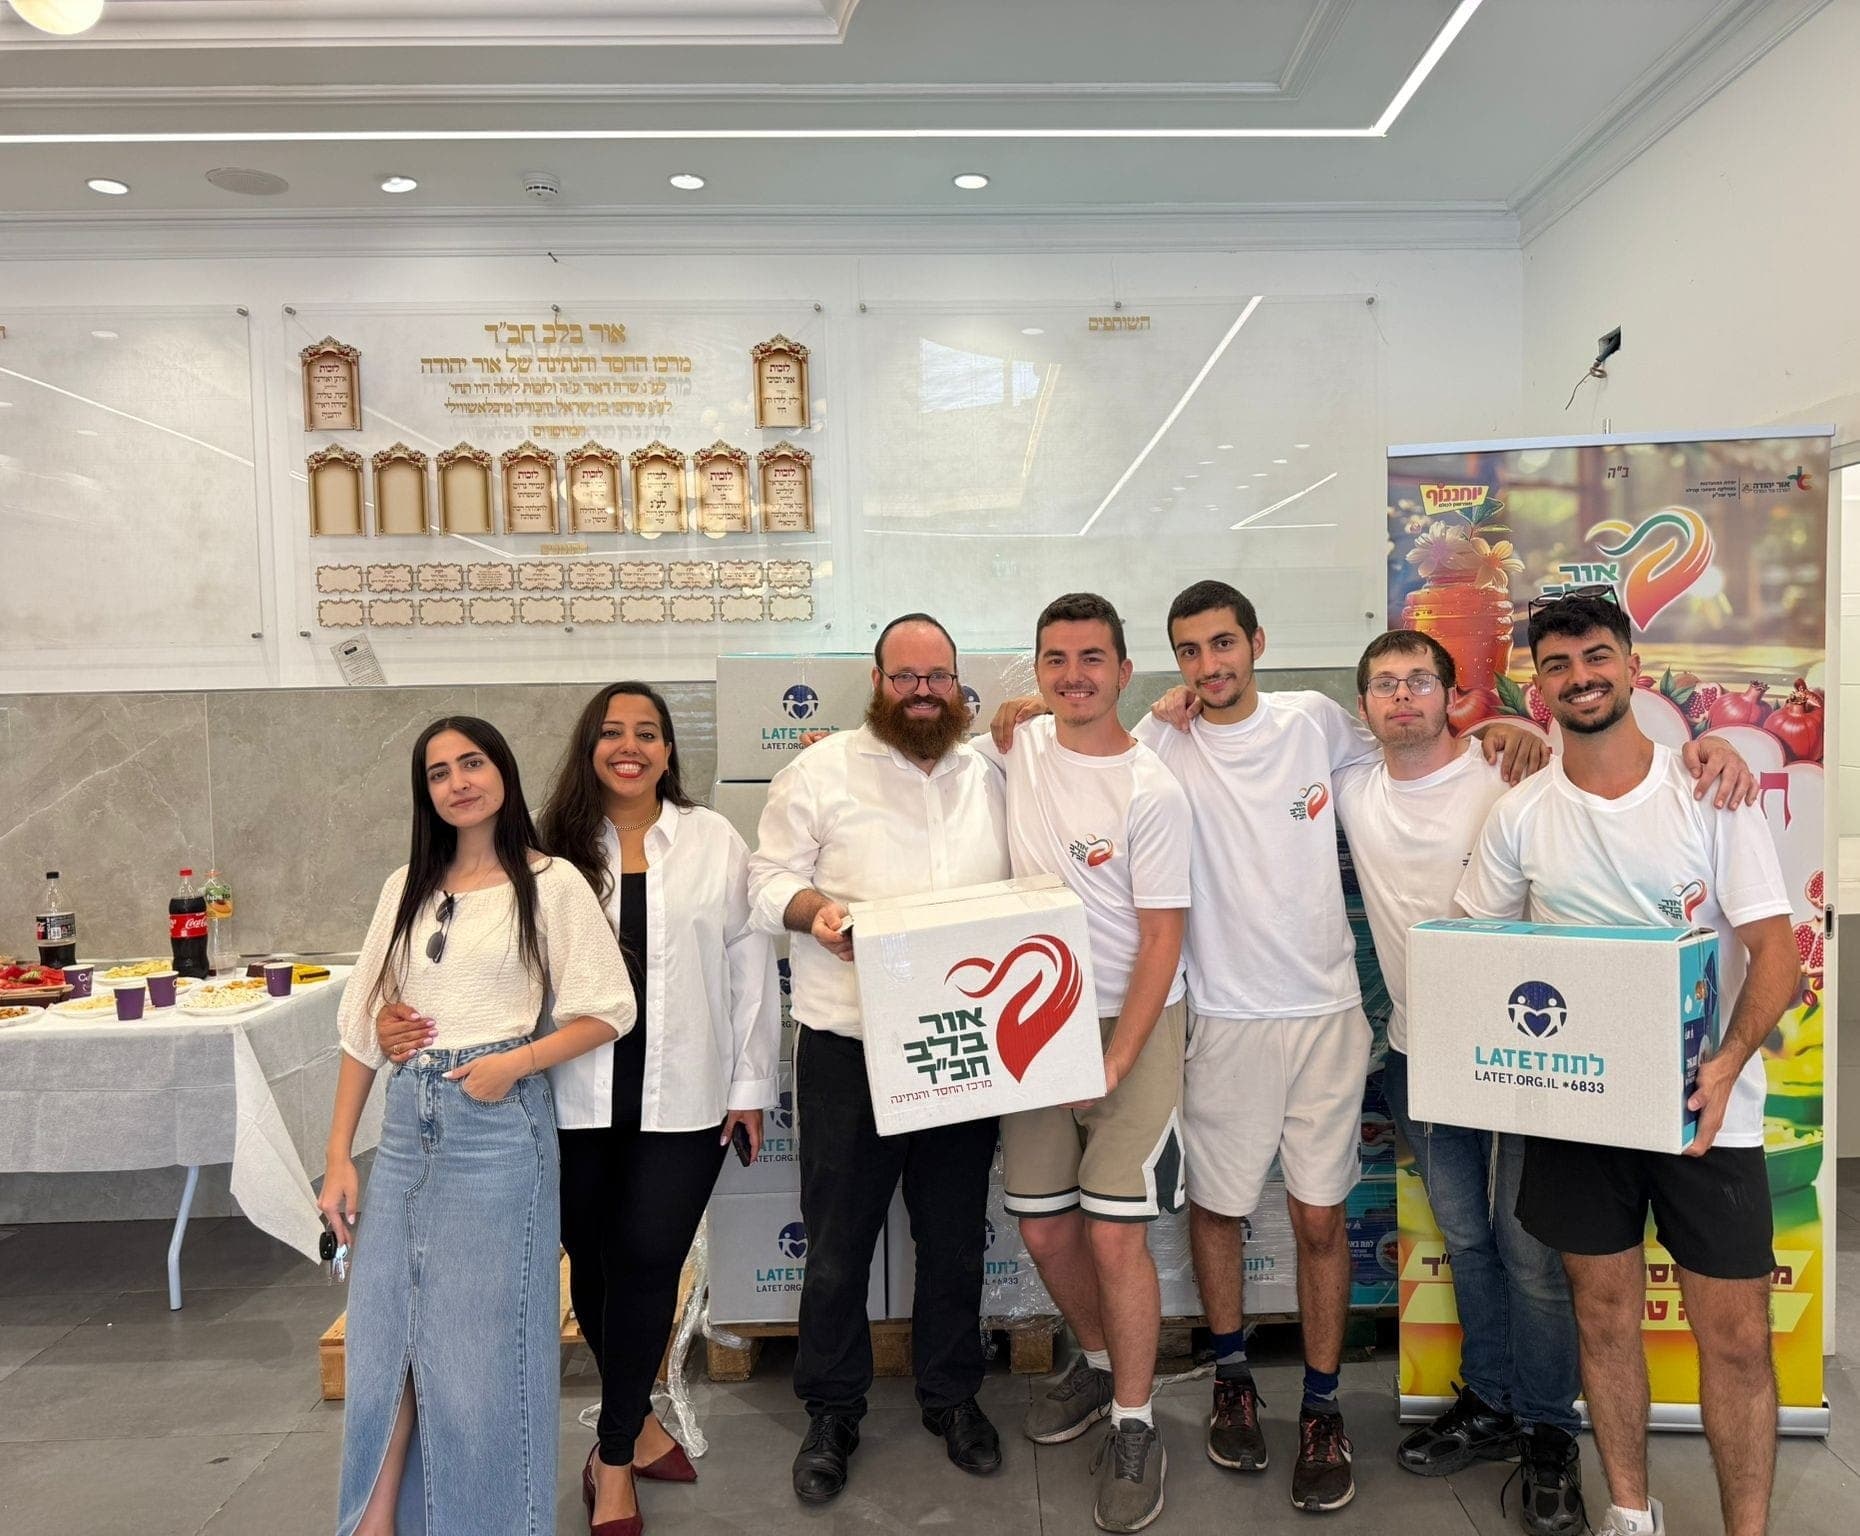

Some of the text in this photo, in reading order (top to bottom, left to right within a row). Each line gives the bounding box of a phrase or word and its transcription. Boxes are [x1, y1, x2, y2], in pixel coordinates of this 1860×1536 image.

[484, 314, 626, 344] אור בלב חב"ד
[1088, 316, 1151, 331] השותפים
[420, 348, 692, 374] מרכז החסד והנתינה של אור יהודה
[1607, 465, 1630, 479] ב"ה
[1426, 484, 1483, 507] יוחננוף
[1558, 563, 1620, 583] אור
[918, 1006, 987, 1034] אור
[903, 1031, 989, 1064] בלב
[917, 1055, 991, 1085] חב"ד
[1475, 1046, 1605, 1076] LATET לתת
[889, 1079, 993, 1104] מרכז החסד והנתינה
[1474, 1070, 1560, 1090] LATET.ORG.IL
[756, 1268, 805, 1282] LATET
[985, 1259, 1018, 1274] לתת
